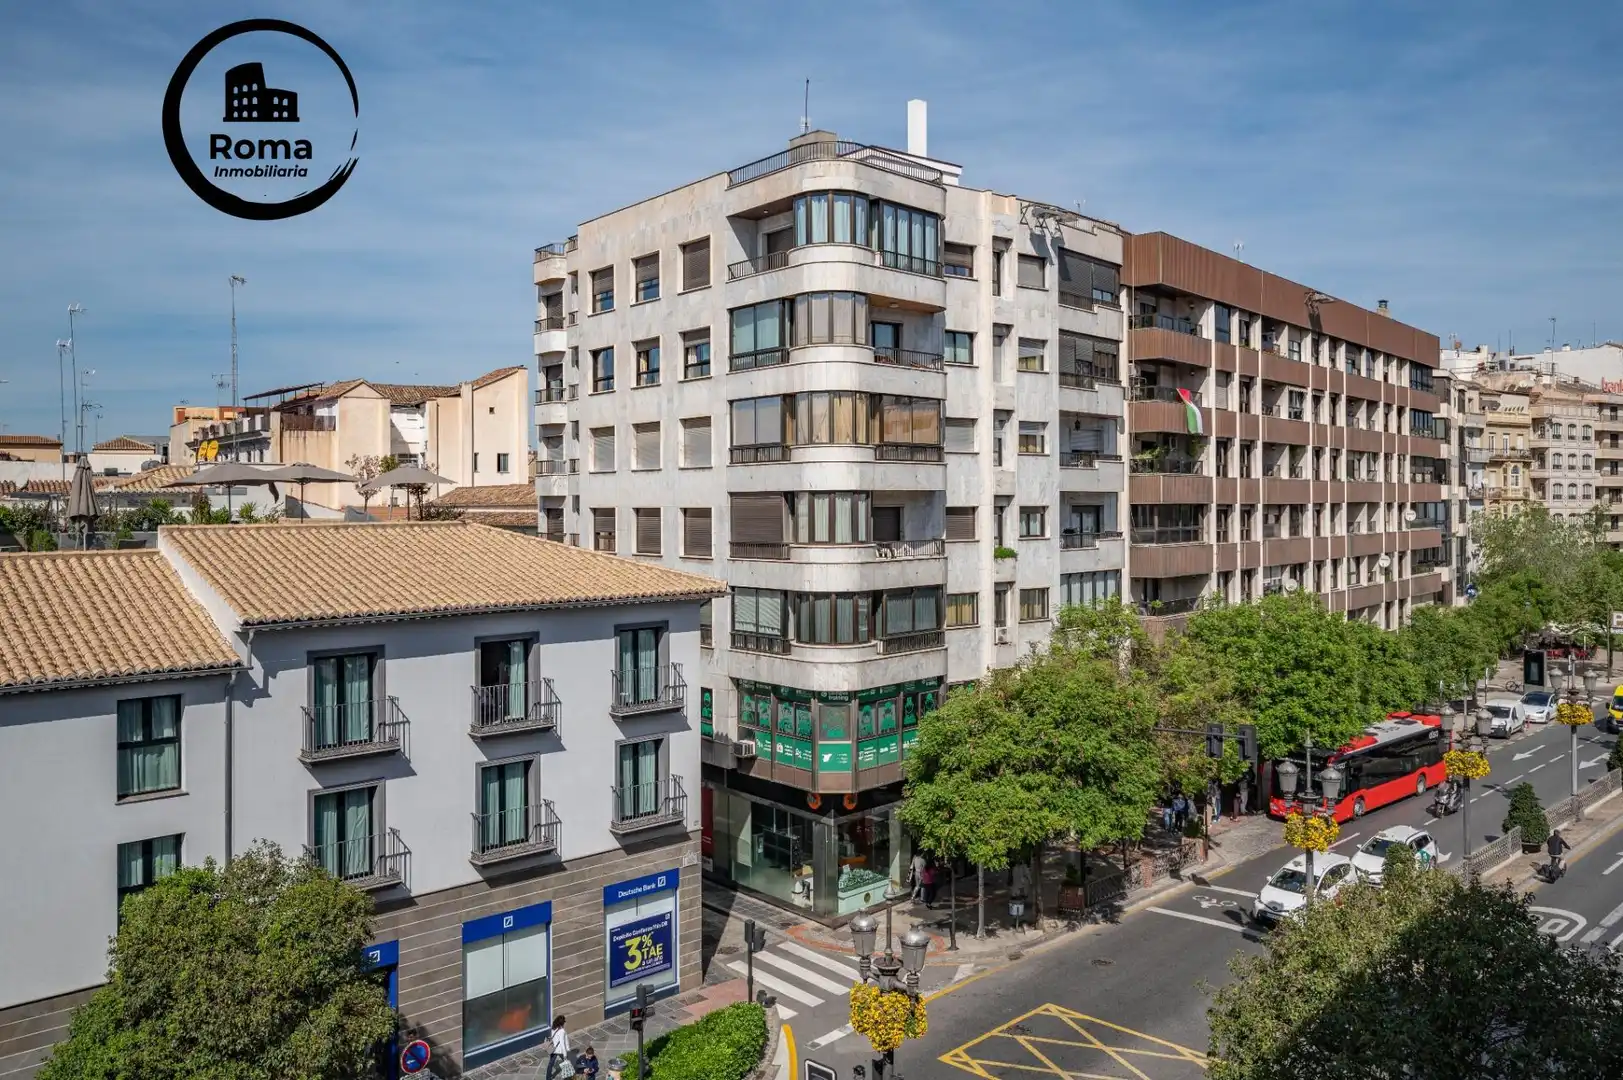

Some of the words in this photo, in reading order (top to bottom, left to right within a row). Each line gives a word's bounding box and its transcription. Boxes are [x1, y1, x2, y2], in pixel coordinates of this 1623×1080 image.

[618, 887, 642, 898] Deutsche
[643, 883, 656, 892] Bank
[642, 943, 663, 959] TAE
